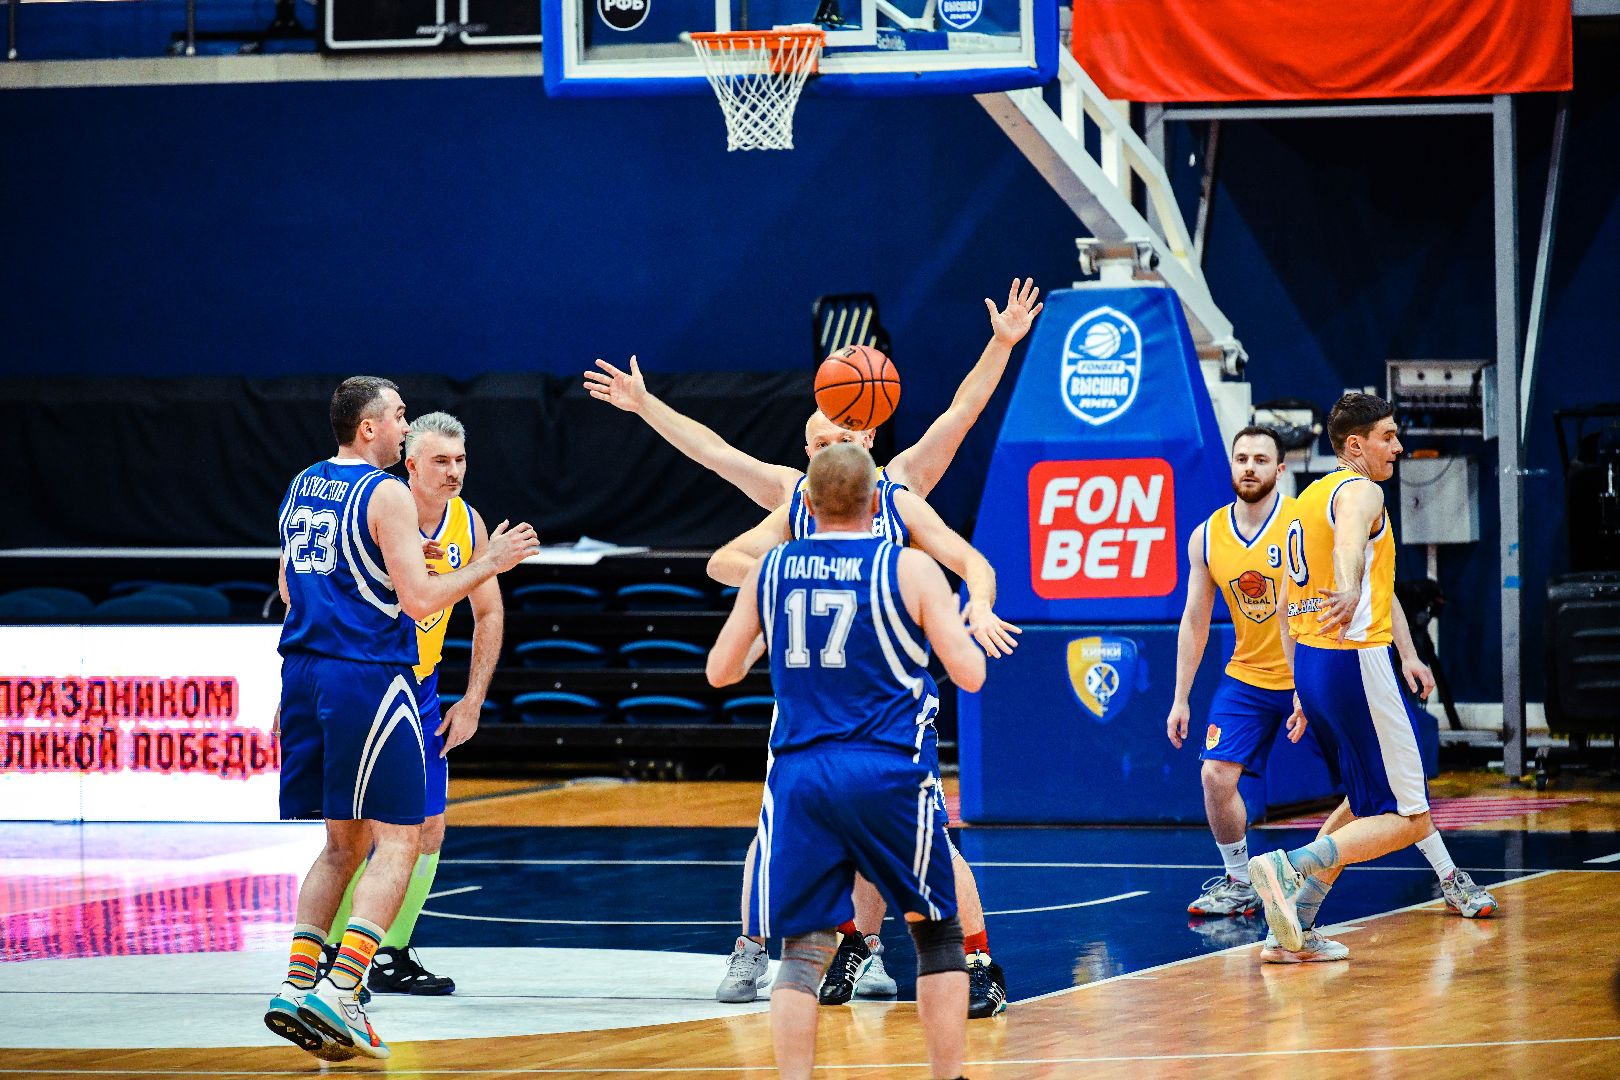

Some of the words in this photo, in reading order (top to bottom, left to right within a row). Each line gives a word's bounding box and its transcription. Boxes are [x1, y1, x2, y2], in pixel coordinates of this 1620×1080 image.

[1071, 376, 1129, 396] ВЫСШАЯ
[1039, 475, 1164, 525] FON
[289, 505, 338, 576] 23
[447, 542, 461, 570] 8
[1041, 528, 1166, 580] BET
[1267, 543, 1282, 569] 9
[784, 555, 863, 581] ПАЛЬЧИК
[1242, 593, 1270, 605] LEGAL
[784, 588, 858, 669] 17
[131, 732, 279, 776] ПОБЕДЫ
